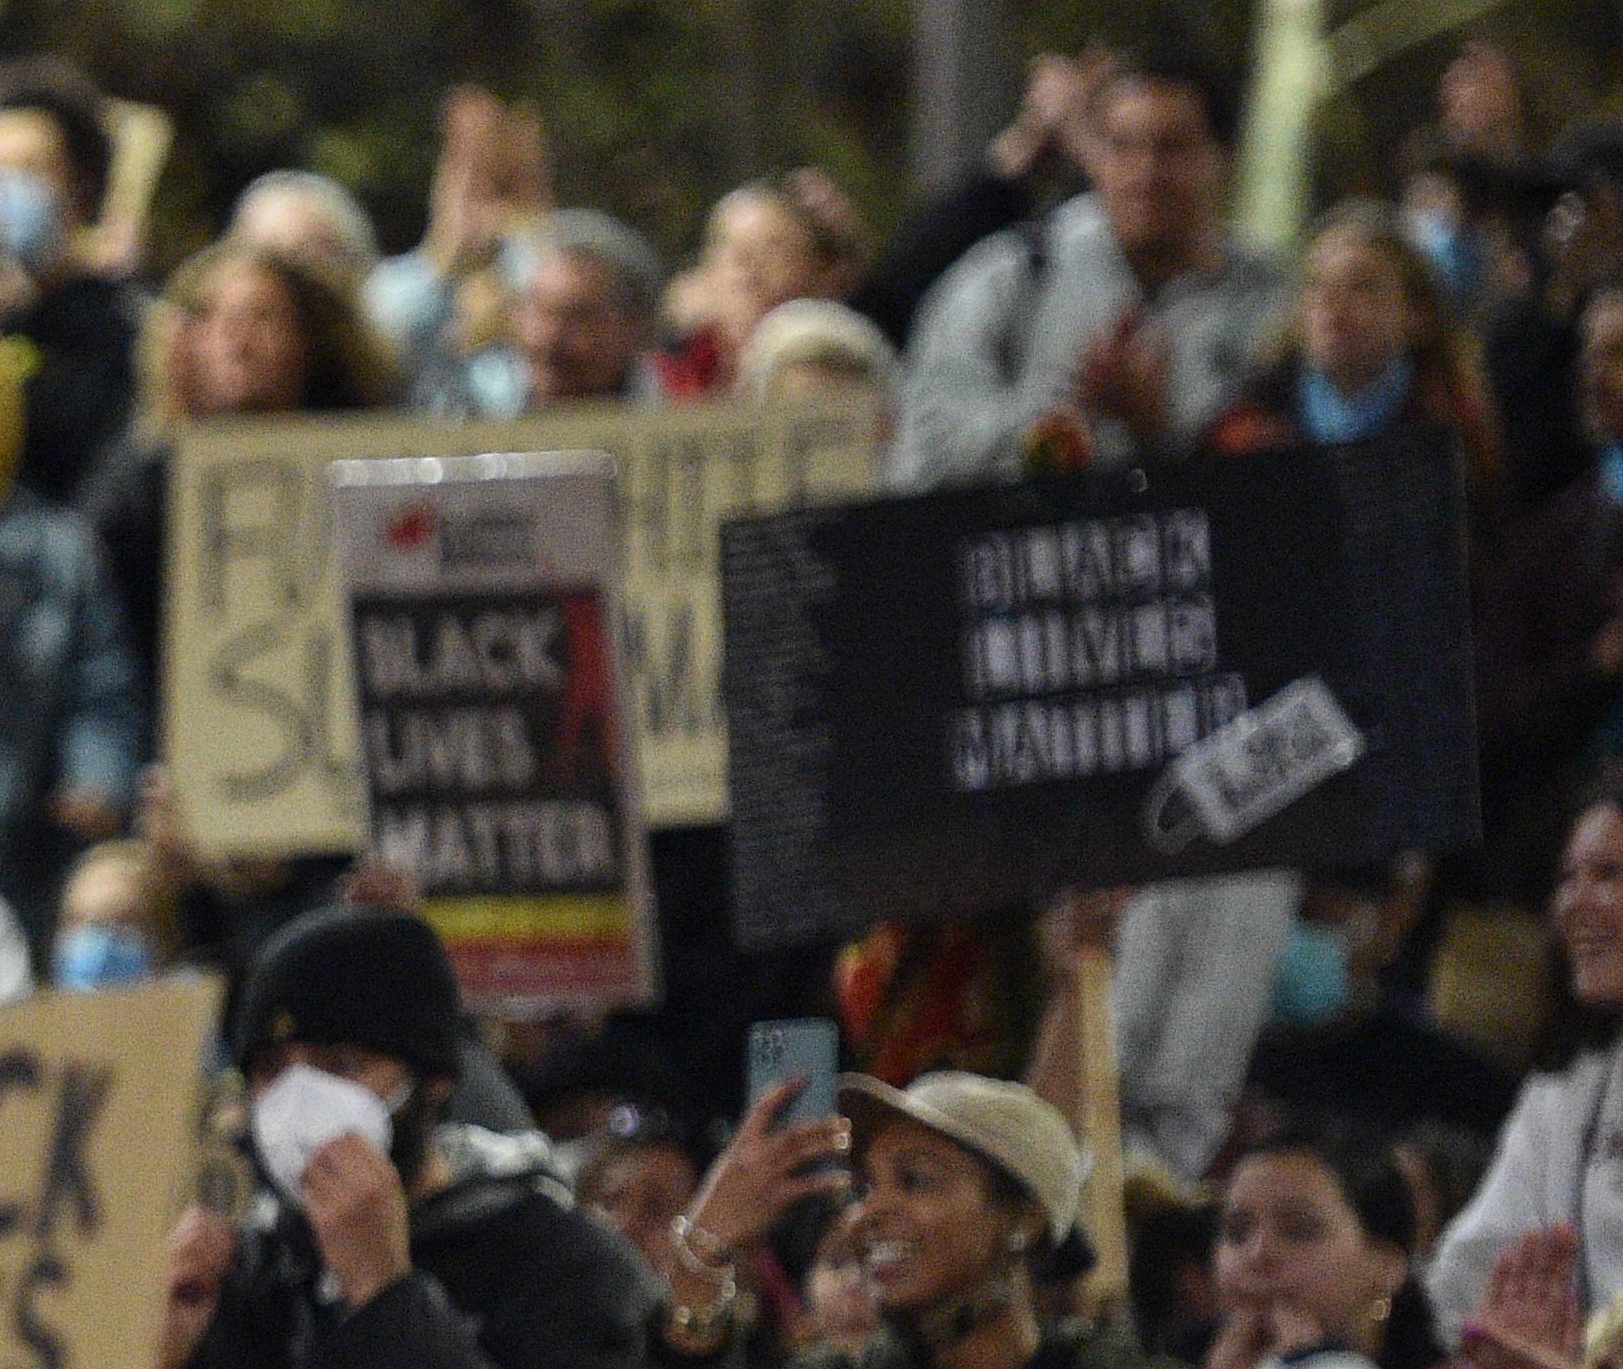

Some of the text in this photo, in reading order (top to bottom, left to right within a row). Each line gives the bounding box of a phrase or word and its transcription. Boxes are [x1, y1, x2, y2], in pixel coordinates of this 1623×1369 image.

[360, 608, 566, 695] BLACK
[363, 706, 538, 788] LIVES
[376, 800, 612, 884] MATTER
